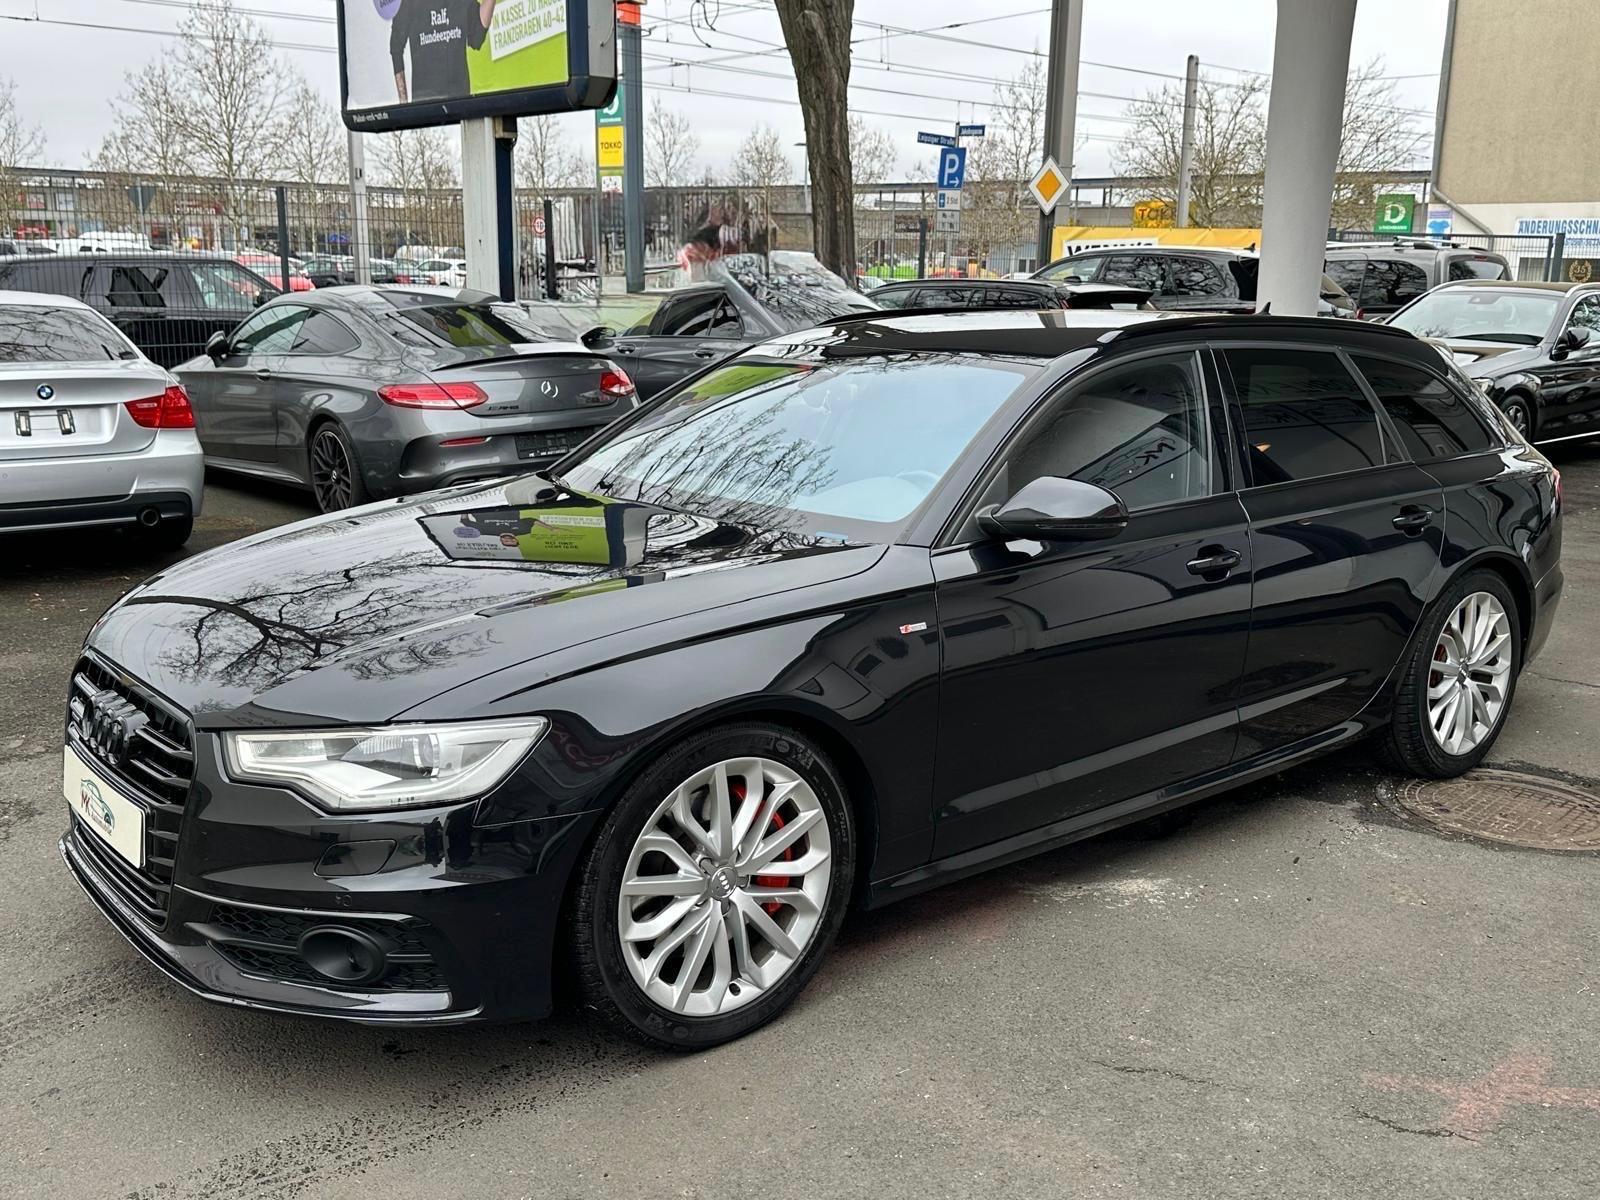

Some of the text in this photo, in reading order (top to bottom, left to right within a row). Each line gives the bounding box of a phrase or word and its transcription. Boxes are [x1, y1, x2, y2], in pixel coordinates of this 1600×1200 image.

[430, 8, 449, 25] Ralf,
[501, 2, 525, 27] KASSEL
[420, 26, 461, 45] Hundeexperte
[494, 15, 541, 49] FRANZGRABEN
[943, 153, 960, 186] P
[1518, 219, 1600, 235] ÄNDERUNGSSCHN
